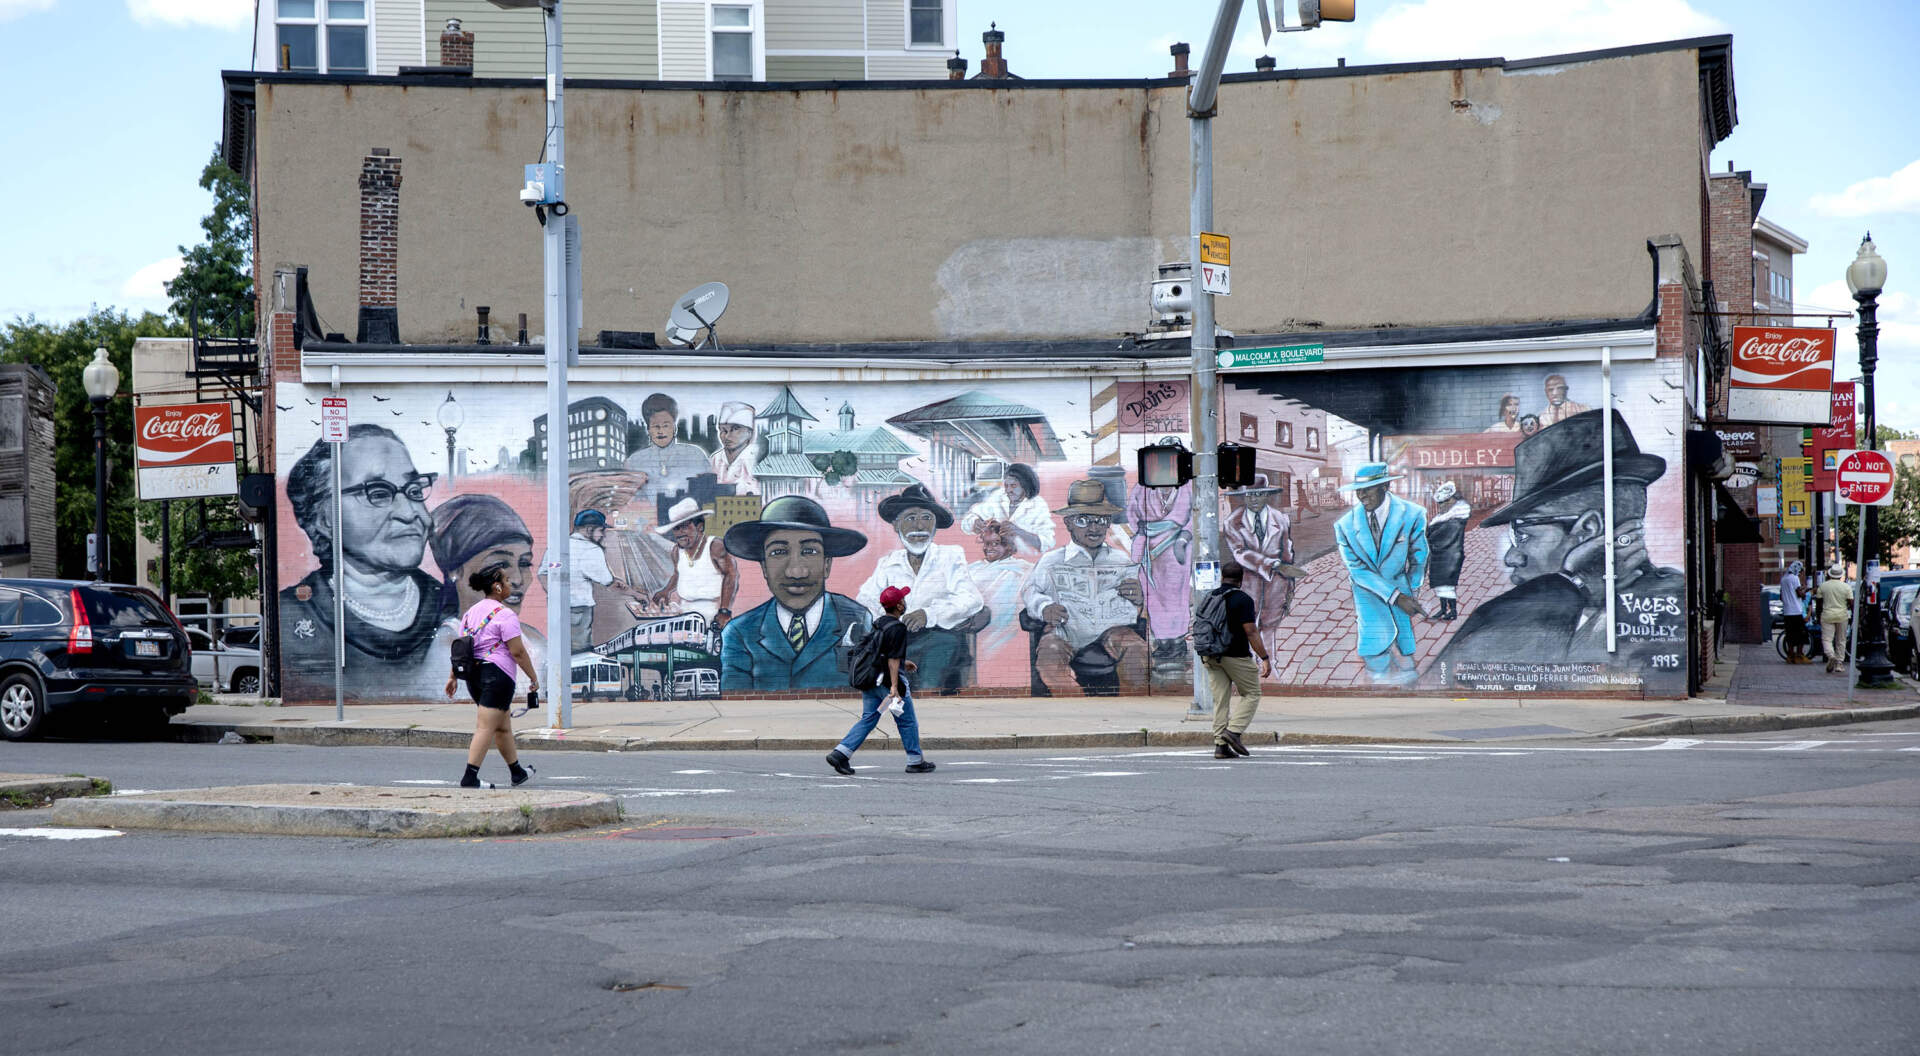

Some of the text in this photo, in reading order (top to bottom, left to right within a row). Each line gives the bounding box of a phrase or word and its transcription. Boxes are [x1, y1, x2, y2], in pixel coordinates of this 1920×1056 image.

[1764, 332, 1783, 340] Enjoy
[1235, 347, 1323, 362] MALCOLM X BOULEVARD
[1739, 336, 1825, 362] Coca-Cola
[142, 412, 223, 440] Coca-Cola
[1145, 419, 1183, 433] STYLE
[1418, 448, 1502, 466] DUDLEY
[1735, 467, 1758, 476] TILLO
[1847, 460, 1885, 471] DO NOT
[1849, 483, 1881, 493] ENTER
[1618, 593, 1681, 616] FACES
[1639, 612, 1660, 626] OF
[1616, 622, 1679, 638] DUDLEY
[1651, 653, 1680, 668] 1995
[1482, 663, 1508, 672] WOMBLE
[1553, 664, 1571, 673] JUAN
[1571, 673, 1609, 684] CHRISTINA
